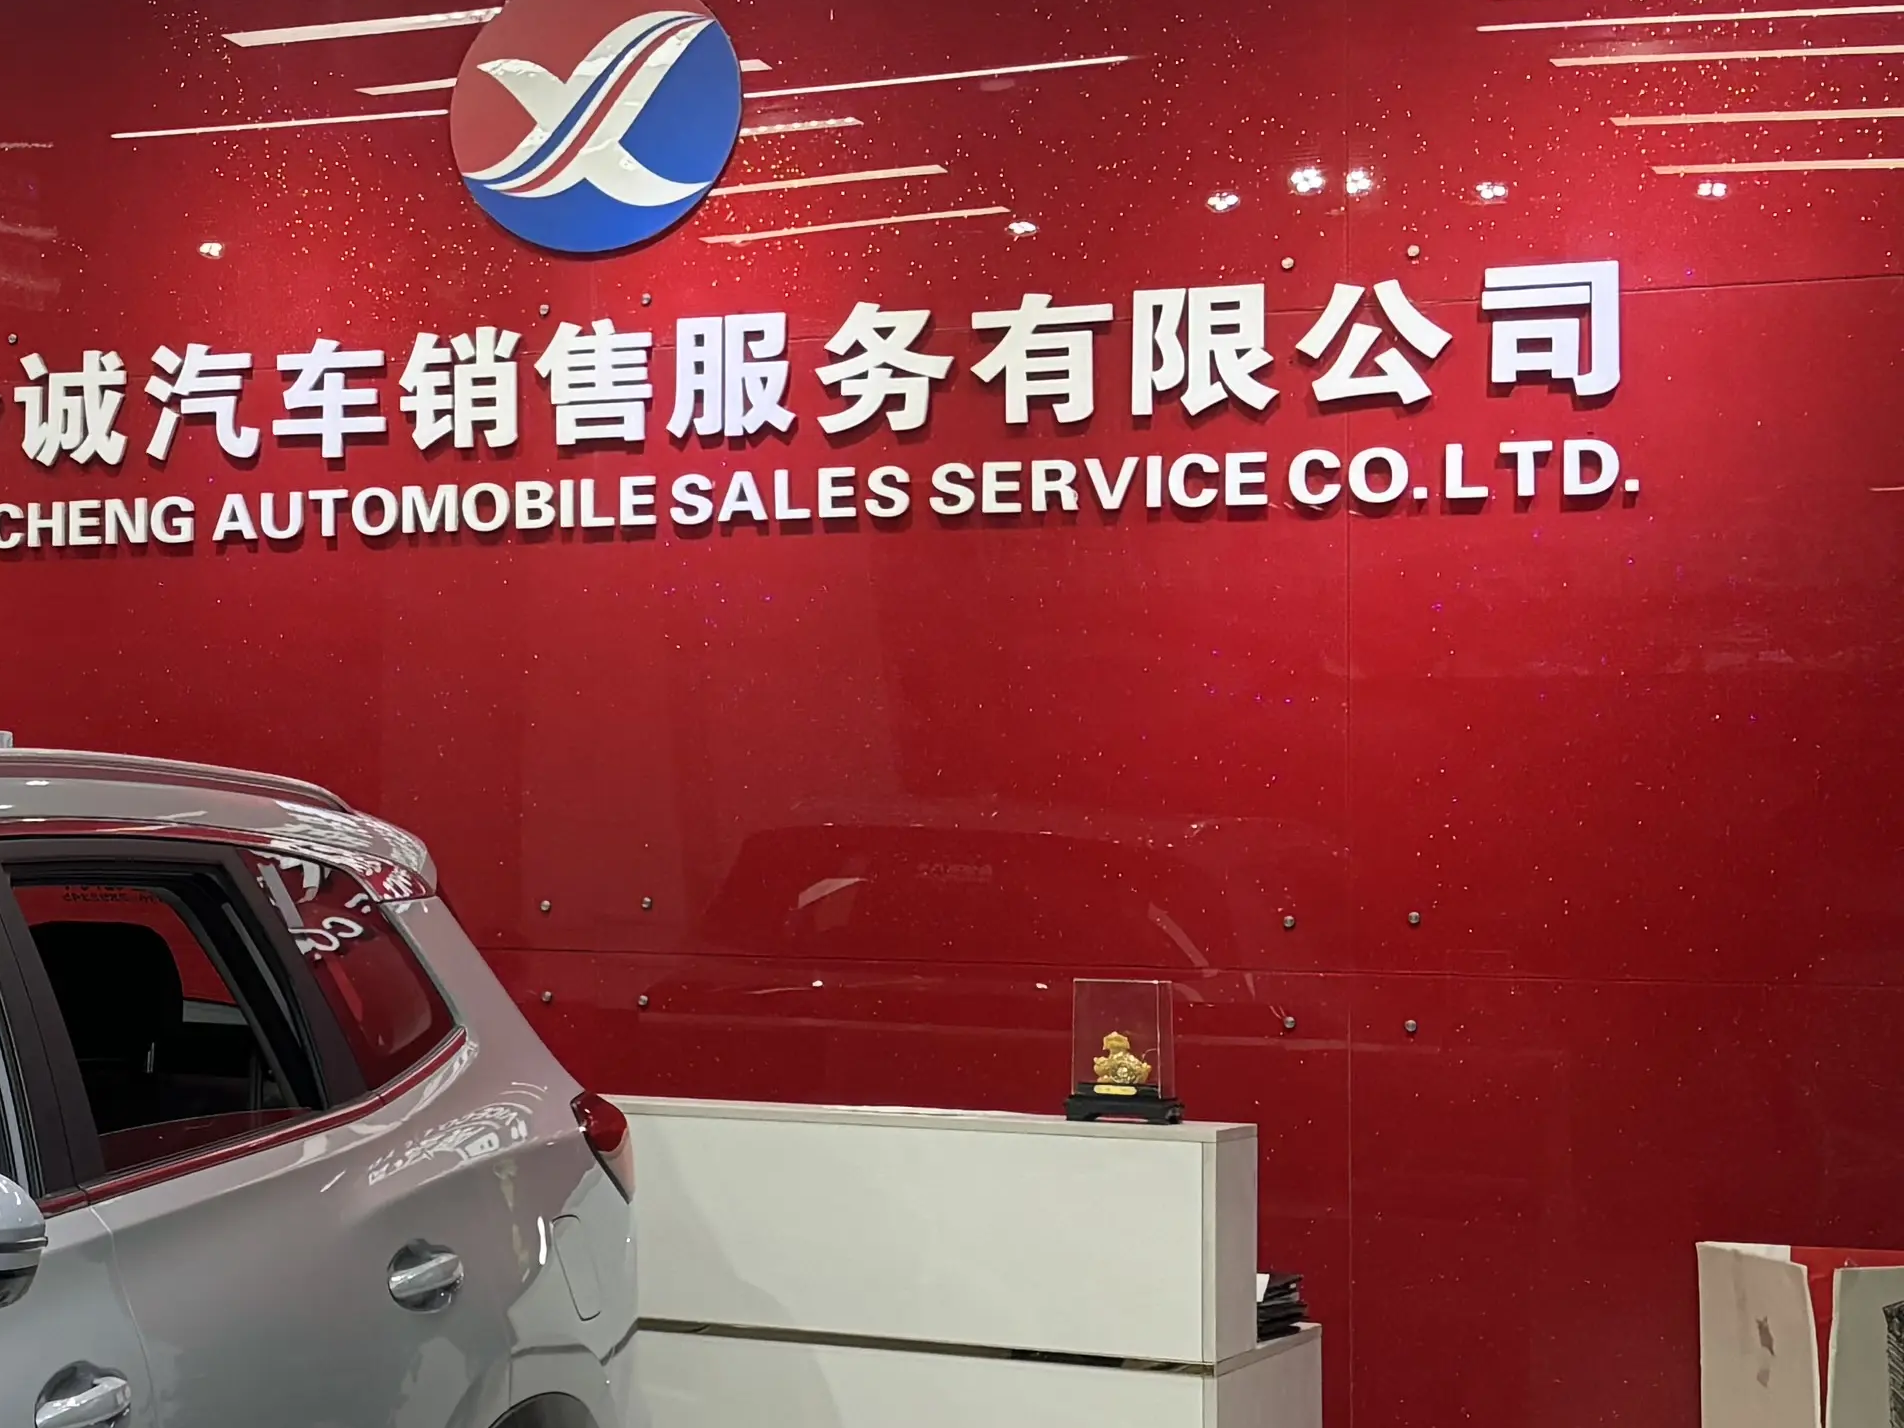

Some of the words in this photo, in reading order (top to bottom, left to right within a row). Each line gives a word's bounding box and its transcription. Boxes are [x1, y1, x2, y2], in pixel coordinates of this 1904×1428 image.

[213, 475, 658, 542] AUTOMOBILE
[669, 464, 912, 528] SALES
[929, 449, 1269, 518] SERVICE
